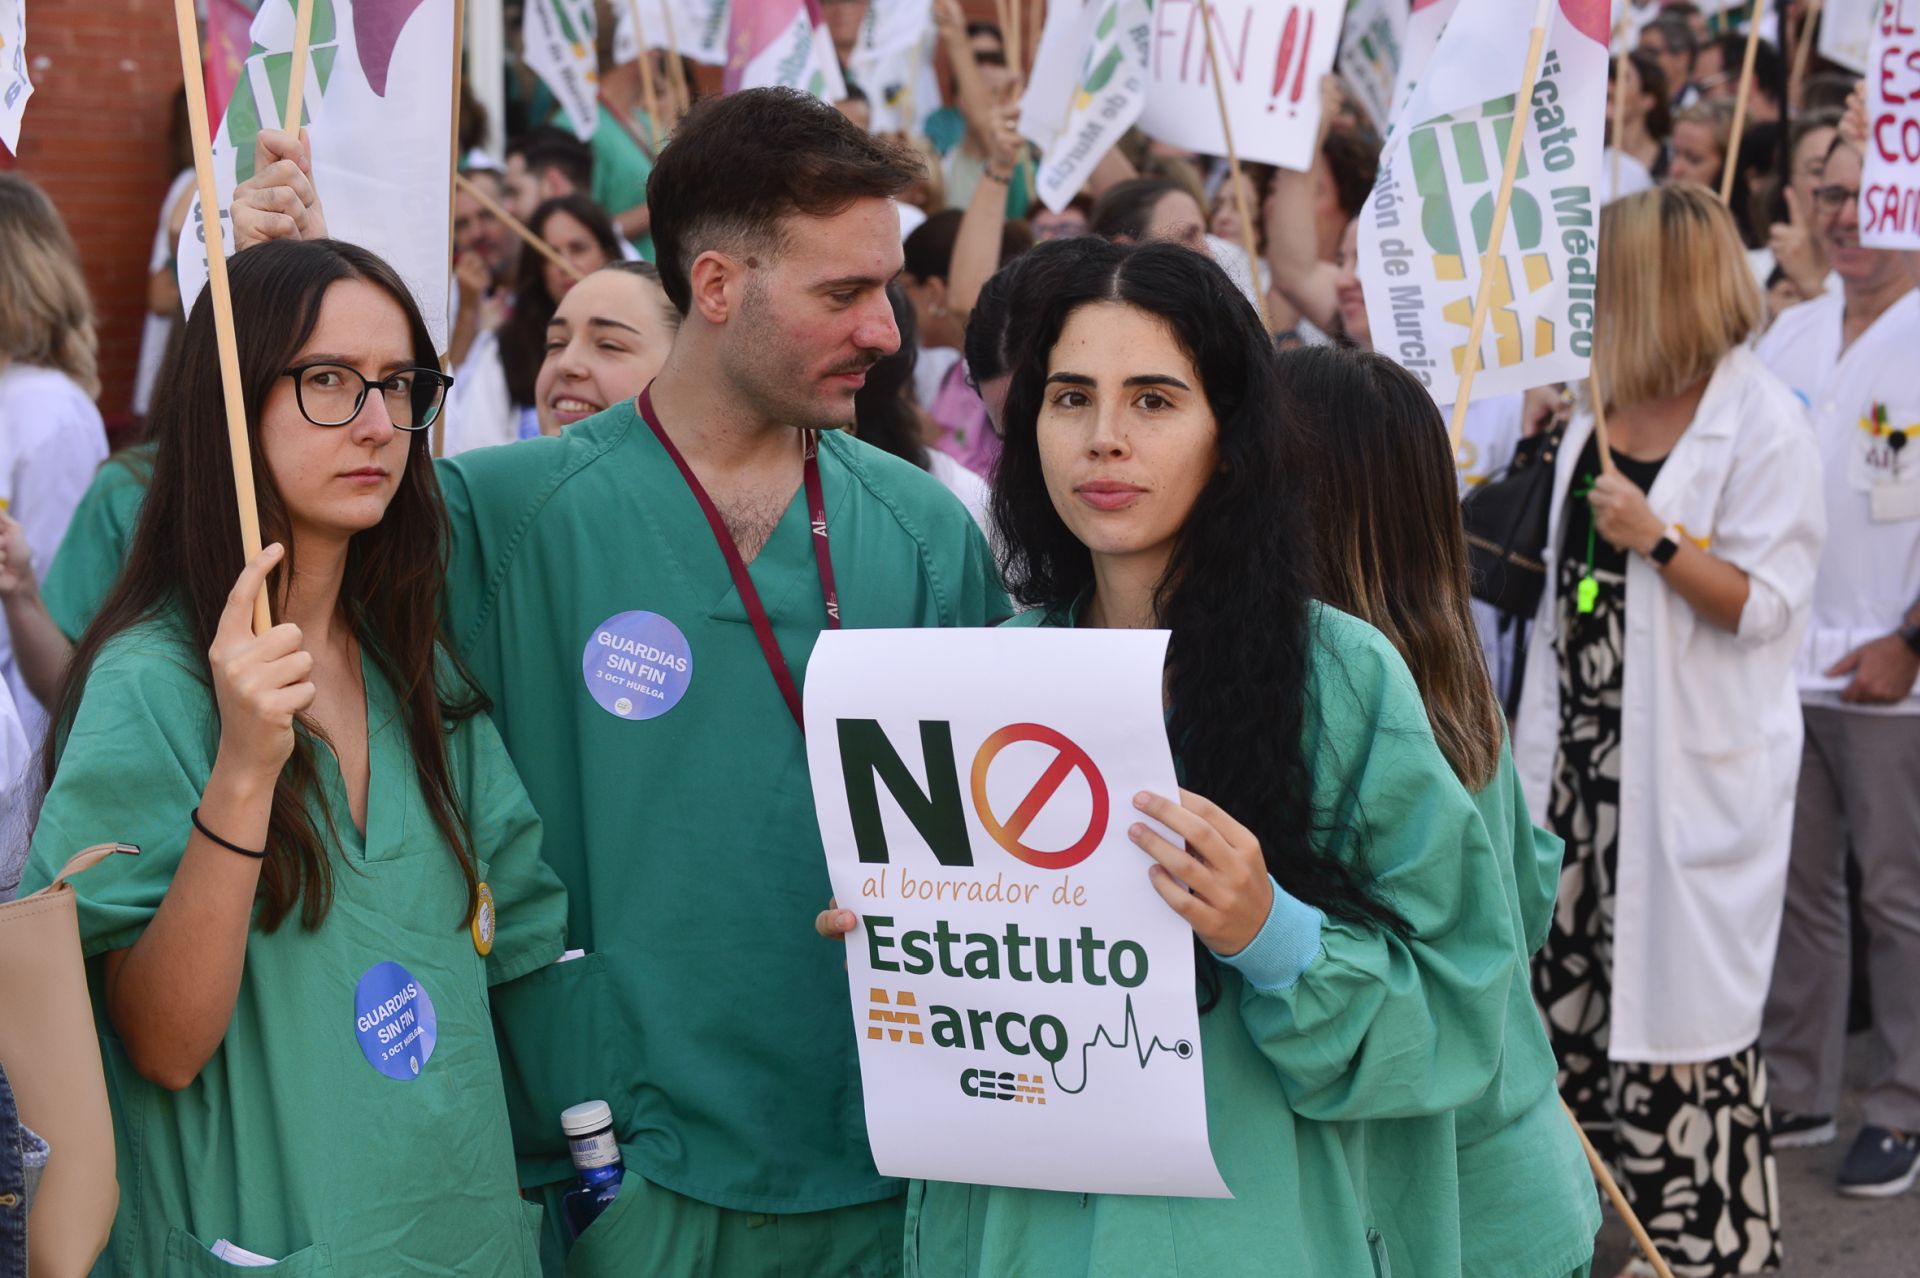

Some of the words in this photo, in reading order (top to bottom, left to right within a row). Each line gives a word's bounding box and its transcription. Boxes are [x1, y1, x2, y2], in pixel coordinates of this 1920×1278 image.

[1530, 50, 1578, 172] icato
[1379, 238, 1415, 277] de
[1550, 186, 1597, 358] Médico
[1389, 285, 1437, 388] Murcia
[597, 631, 688, 672] GUARDIAS
[606, 654, 637, 674] SIN
[638, 664, 666, 685] FIN
[596, 670, 603, 678] 3
[605, 673, 625, 685] OCT
[626, 680, 665, 700] HUELGA
[836, 718, 1109, 870] NO
[862, 868, 886, 899] al
[900, 867, 1039, 904] borrador
[1052, 874, 1088, 907] de
[861, 914, 1149, 988] Estatuto
[357, 983, 418, 1033] GUARDIAS
[377, 1019, 402, 1044] SIN
[400, 1008, 415, 1030] FIN
[867, 987, 1069, 1062] Marco
[381, 1052, 389, 1061] 3
[388, 1041, 404, 1057] OCT
[403, 1025, 425, 1048] HUELGA
[960, 1068, 1046, 1105] CESM
